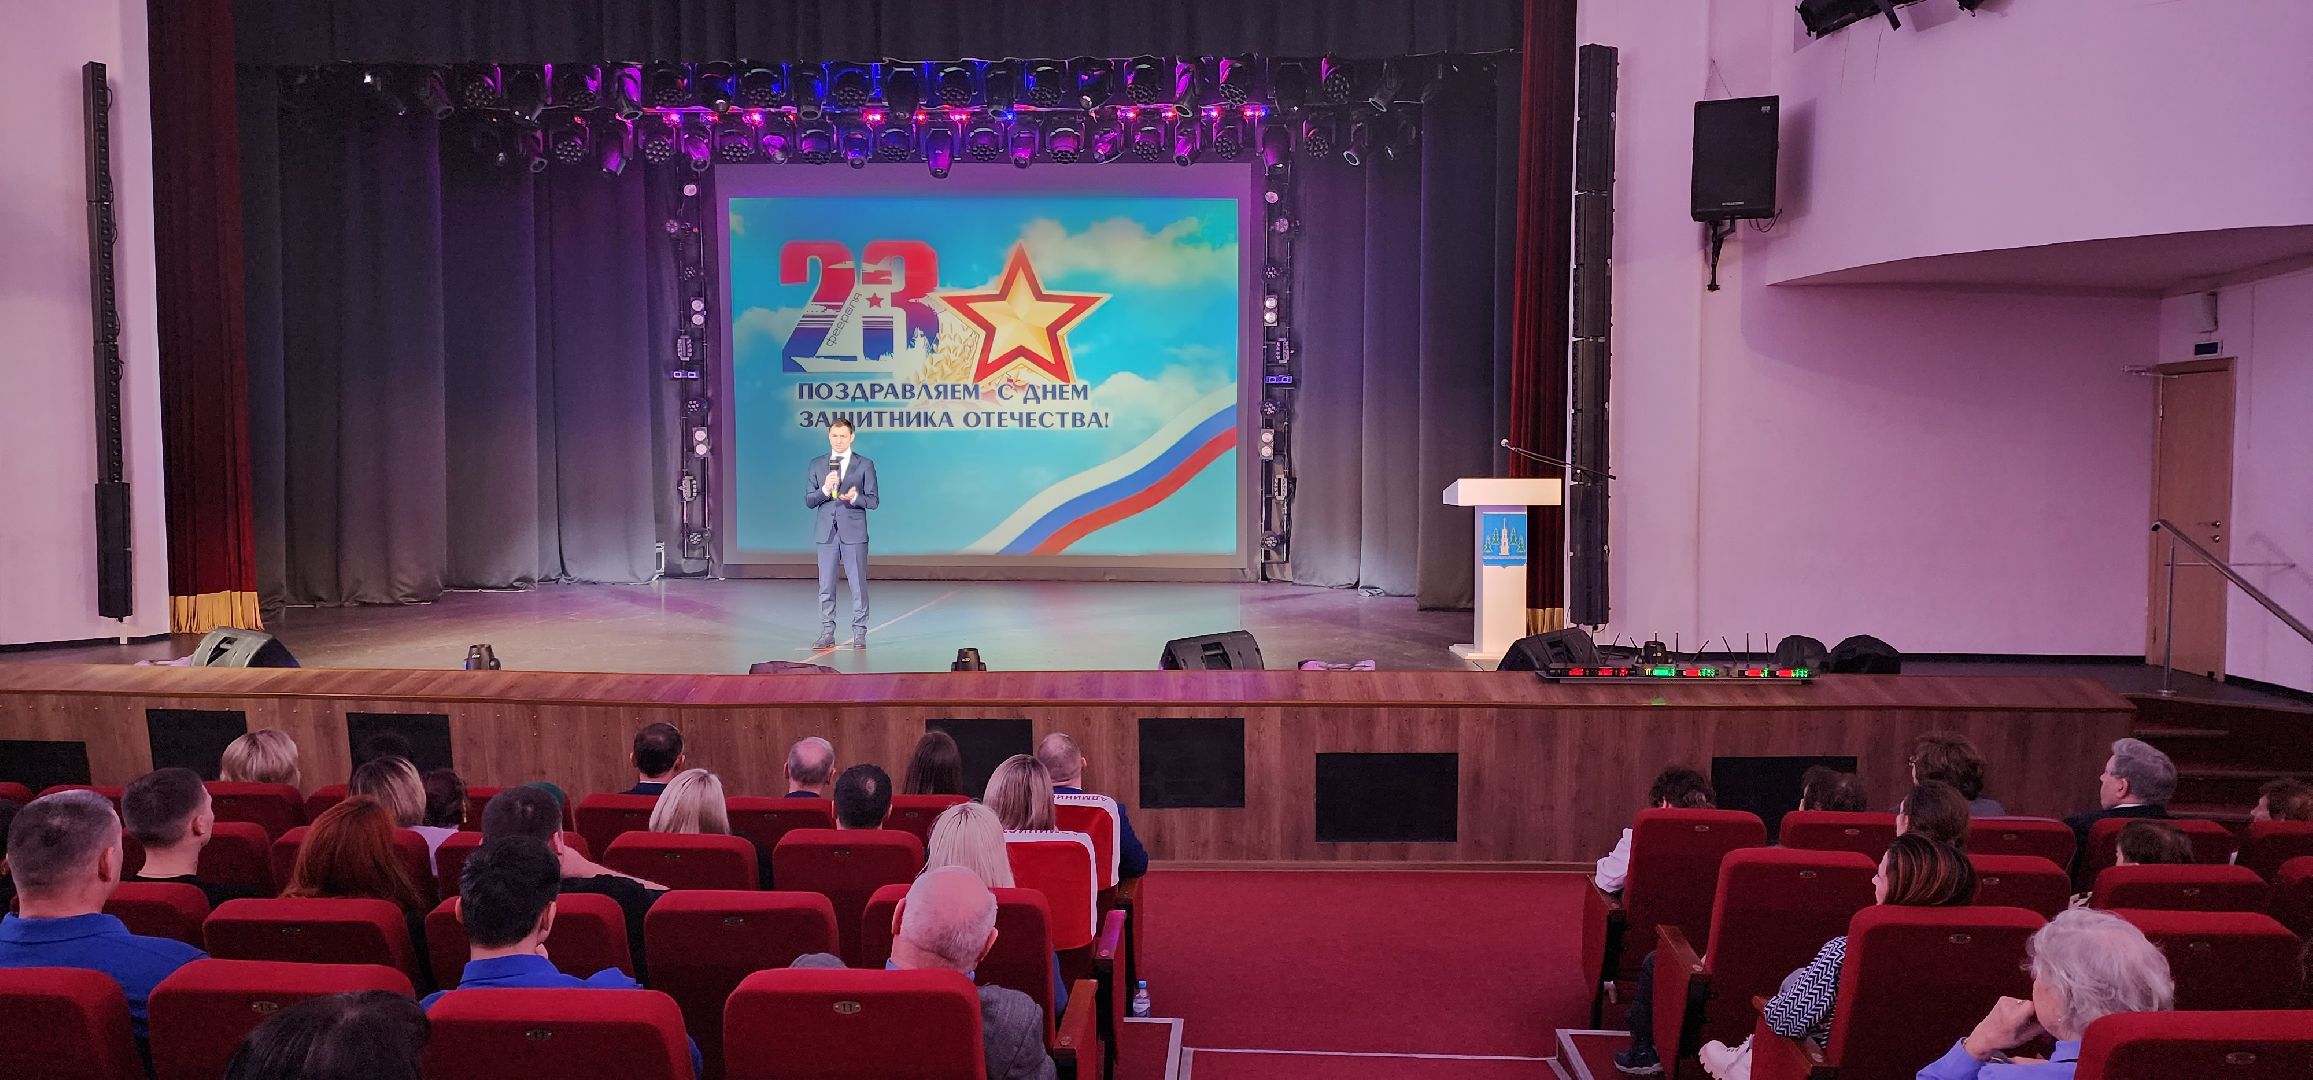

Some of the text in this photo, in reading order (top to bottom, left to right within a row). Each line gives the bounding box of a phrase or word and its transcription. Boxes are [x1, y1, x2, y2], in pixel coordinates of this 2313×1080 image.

[780, 240, 939, 373] 23
[798, 383, 1088, 405] ПОЗДРАВЛЯЕМ С ДНЕМ
[962, 411, 1109, 428] ОТЕЧЕСТВА!
